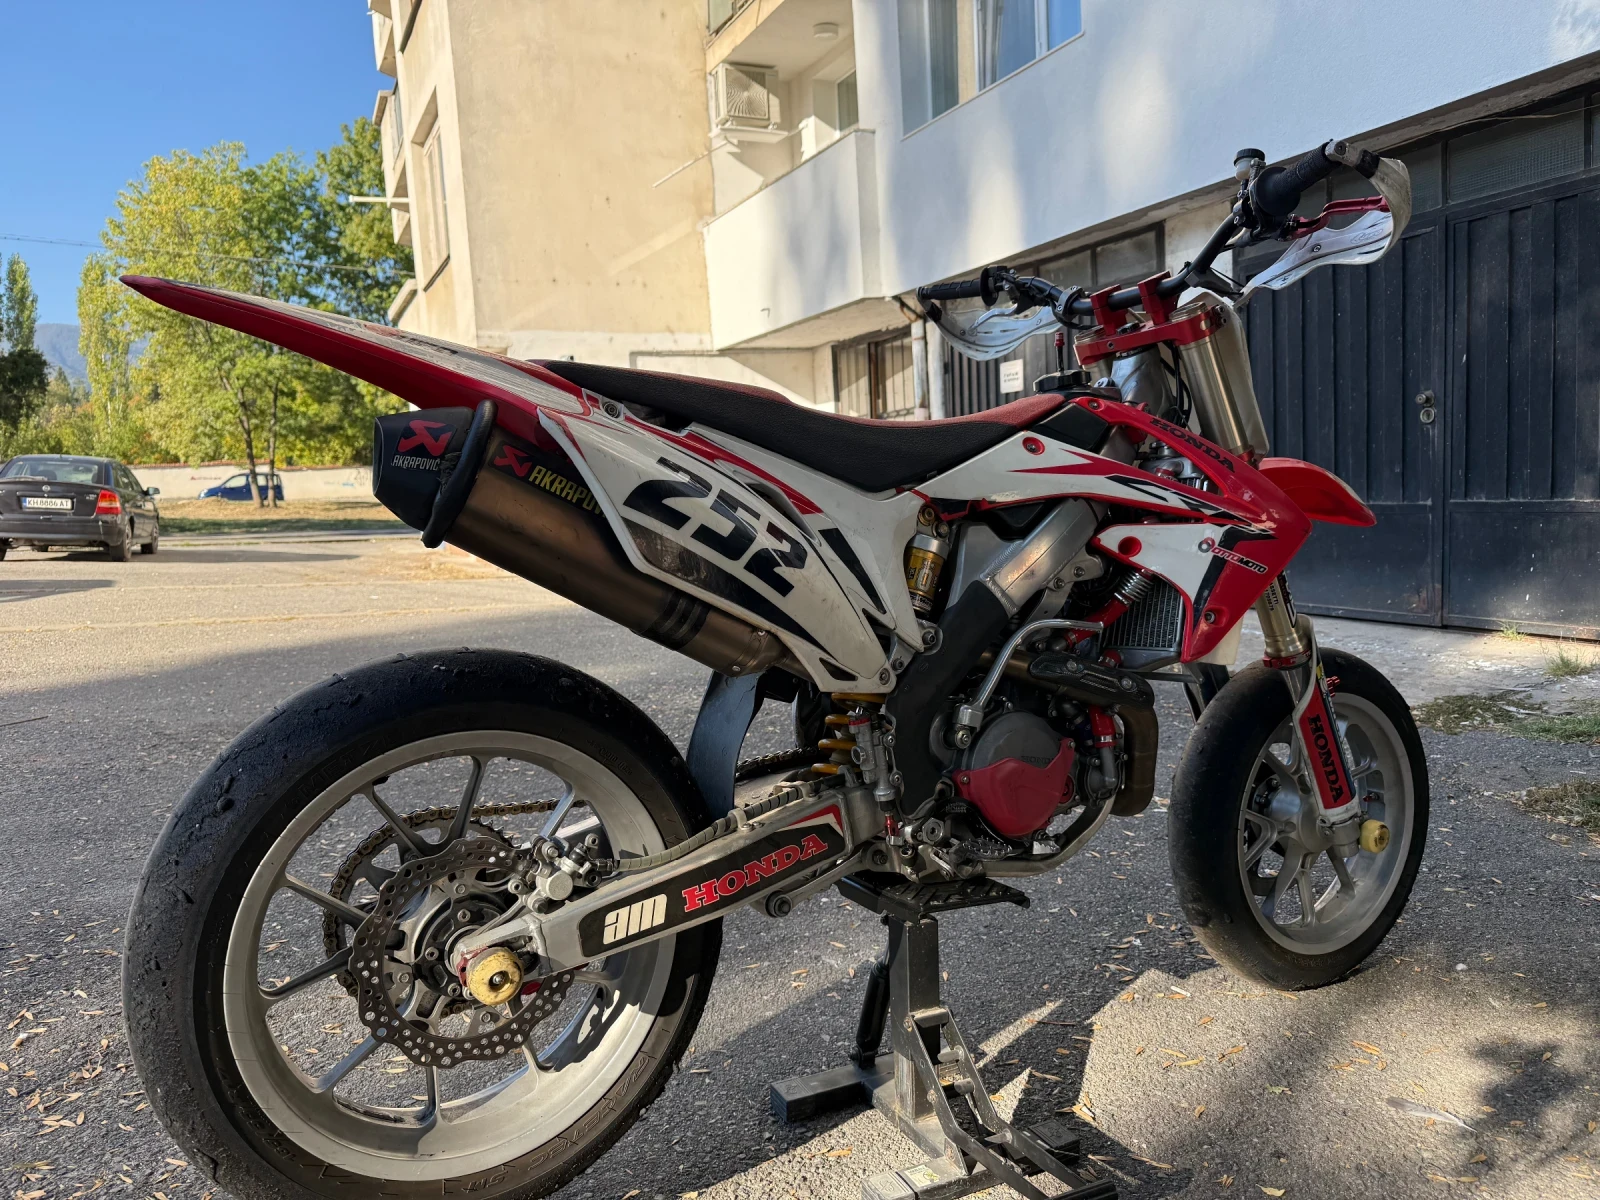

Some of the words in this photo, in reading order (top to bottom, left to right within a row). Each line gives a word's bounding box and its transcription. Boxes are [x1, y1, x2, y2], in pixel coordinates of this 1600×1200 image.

[1150, 418, 1236, 473] HONDA
[623, 456, 808, 598] 252
[1210, 546, 1268, 574] OTTOMOTO
[1020, 755, 1054, 764] HOND
[1308, 713, 1345, 803] HONDA
[682, 832, 828, 913] HONDA
